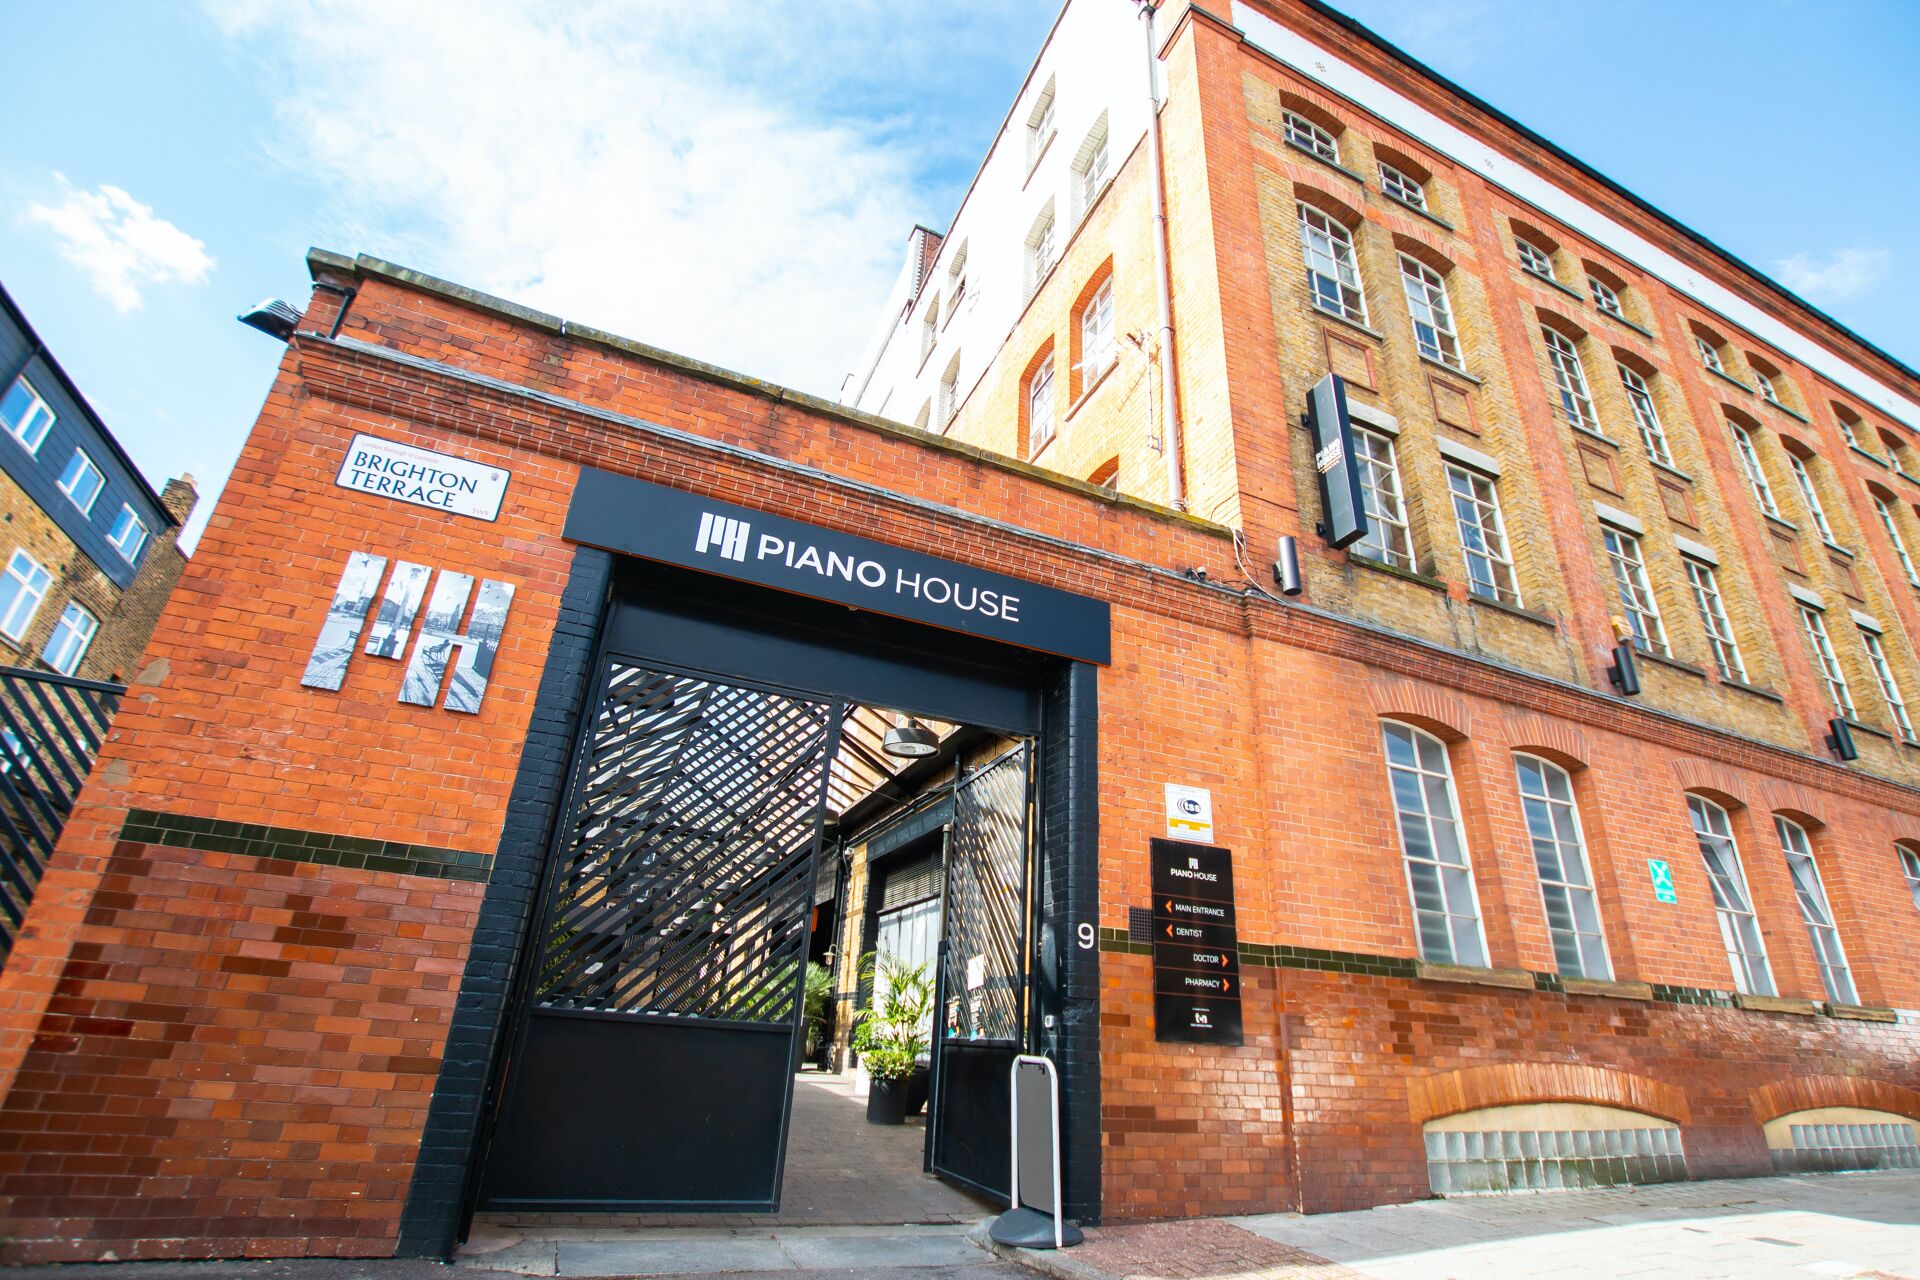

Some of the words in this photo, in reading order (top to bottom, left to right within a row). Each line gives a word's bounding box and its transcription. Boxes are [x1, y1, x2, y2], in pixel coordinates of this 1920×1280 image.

[353, 451, 478, 494] BRIGHTON
[351, 468, 456, 508] TERRACE
[757, 533, 886, 588] PIANO
[895, 568, 1020, 622] HOUSE
[1170, 868, 1193, 878] PIANO
[1193, 872, 1217, 882] HOUSE
[1175, 904, 1192, 913] MAIN
[1192, 906, 1225, 917] ENTRANCE
[1078, 923, 1094, 949] 9
[1176, 927, 1203, 938] DENTIST
[1193, 953, 1219, 964] DOCTOR
[1185, 977, 1220, 988] PHARMACY
